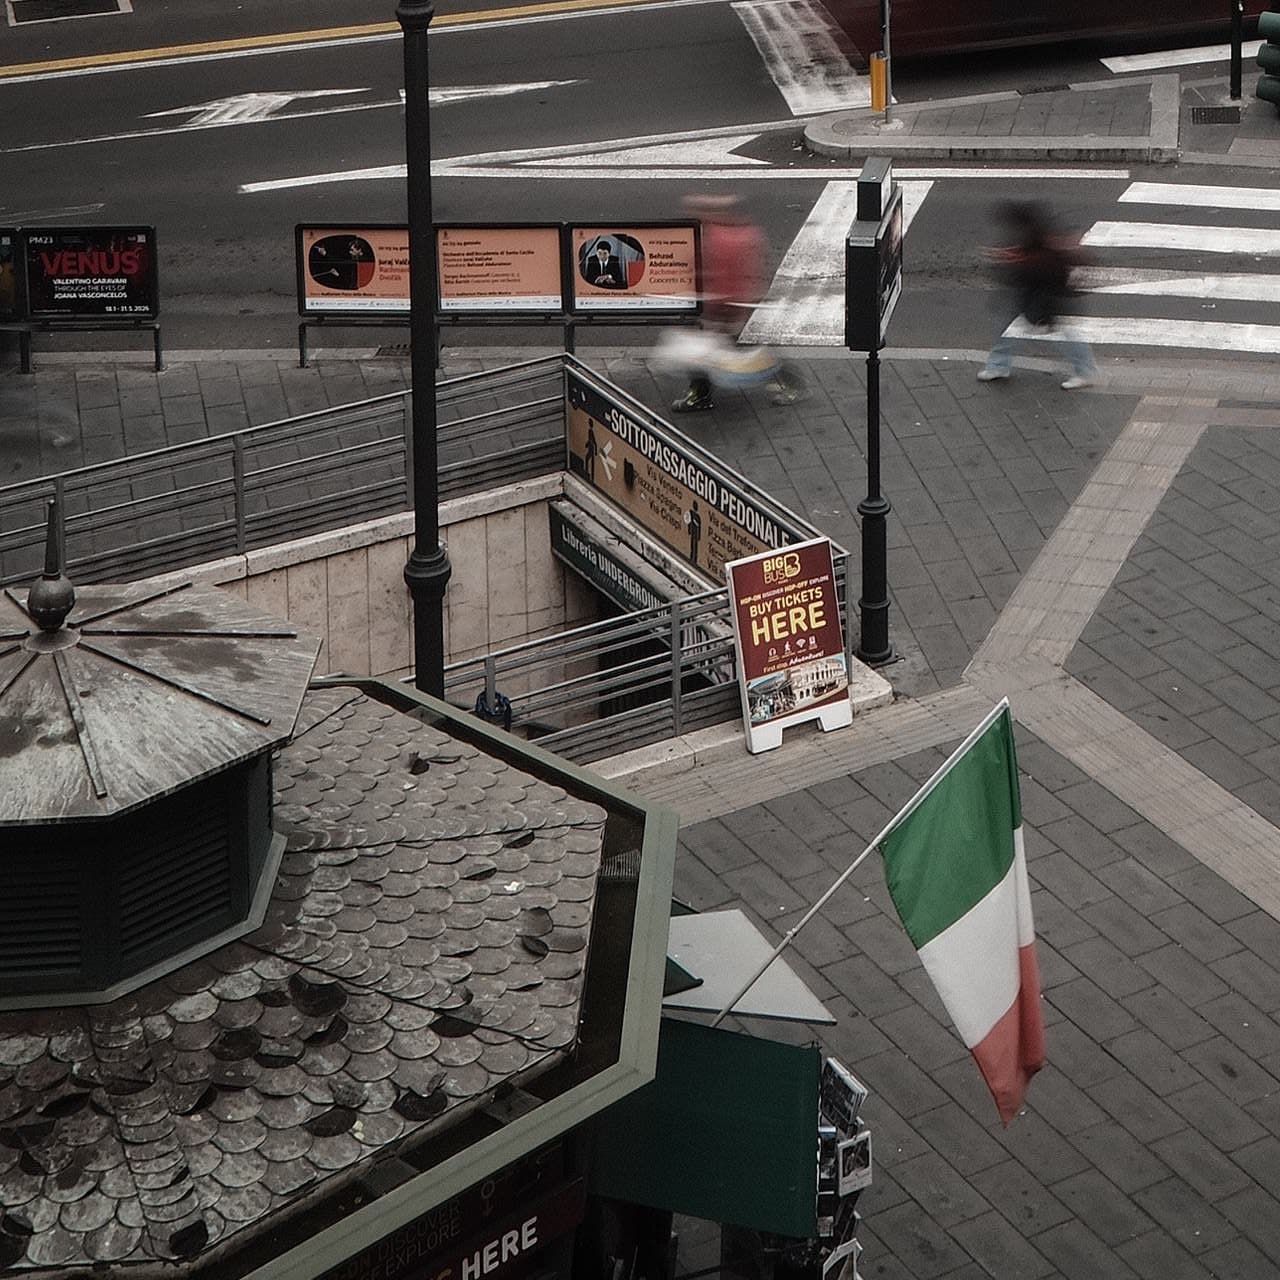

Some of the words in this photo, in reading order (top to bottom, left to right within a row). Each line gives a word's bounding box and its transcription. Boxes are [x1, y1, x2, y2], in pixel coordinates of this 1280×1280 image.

[40, 250, 141, 276] VENUS
[79, 291, 128, 299] VASCONCELOS
[610, 407, 718, 507] SOTTOPASSAGGIO
[720, 487, 790, 549] PEDONALE
[646, 463, 658, 481] Via
[658, 479, 683, 500] Veneto
[650, 498, 660, 514] Via
[657, 491, 682, 516] Spagna
[708, 510, 719, 527] Via
[720, 522, 732, 536] del
[561, 523, 598, 567] Libreria
[598, 552, 668, 617] UNDERGROUN
[762, 556, 784, 573] BIG
[763, 568, 785, 585] BUS
[740, 593, 762, 606] HOP-ON
[784, 579, 809, 593] HOP-OFF
[808, 574, 830, 586] EXPLORE
[749, 600, 772, 618] BUY
[774, 586, 823, 611] TICKETS
[751, 600, 827, 647] HERE
[461, 1215, 539, 1280] HERE
